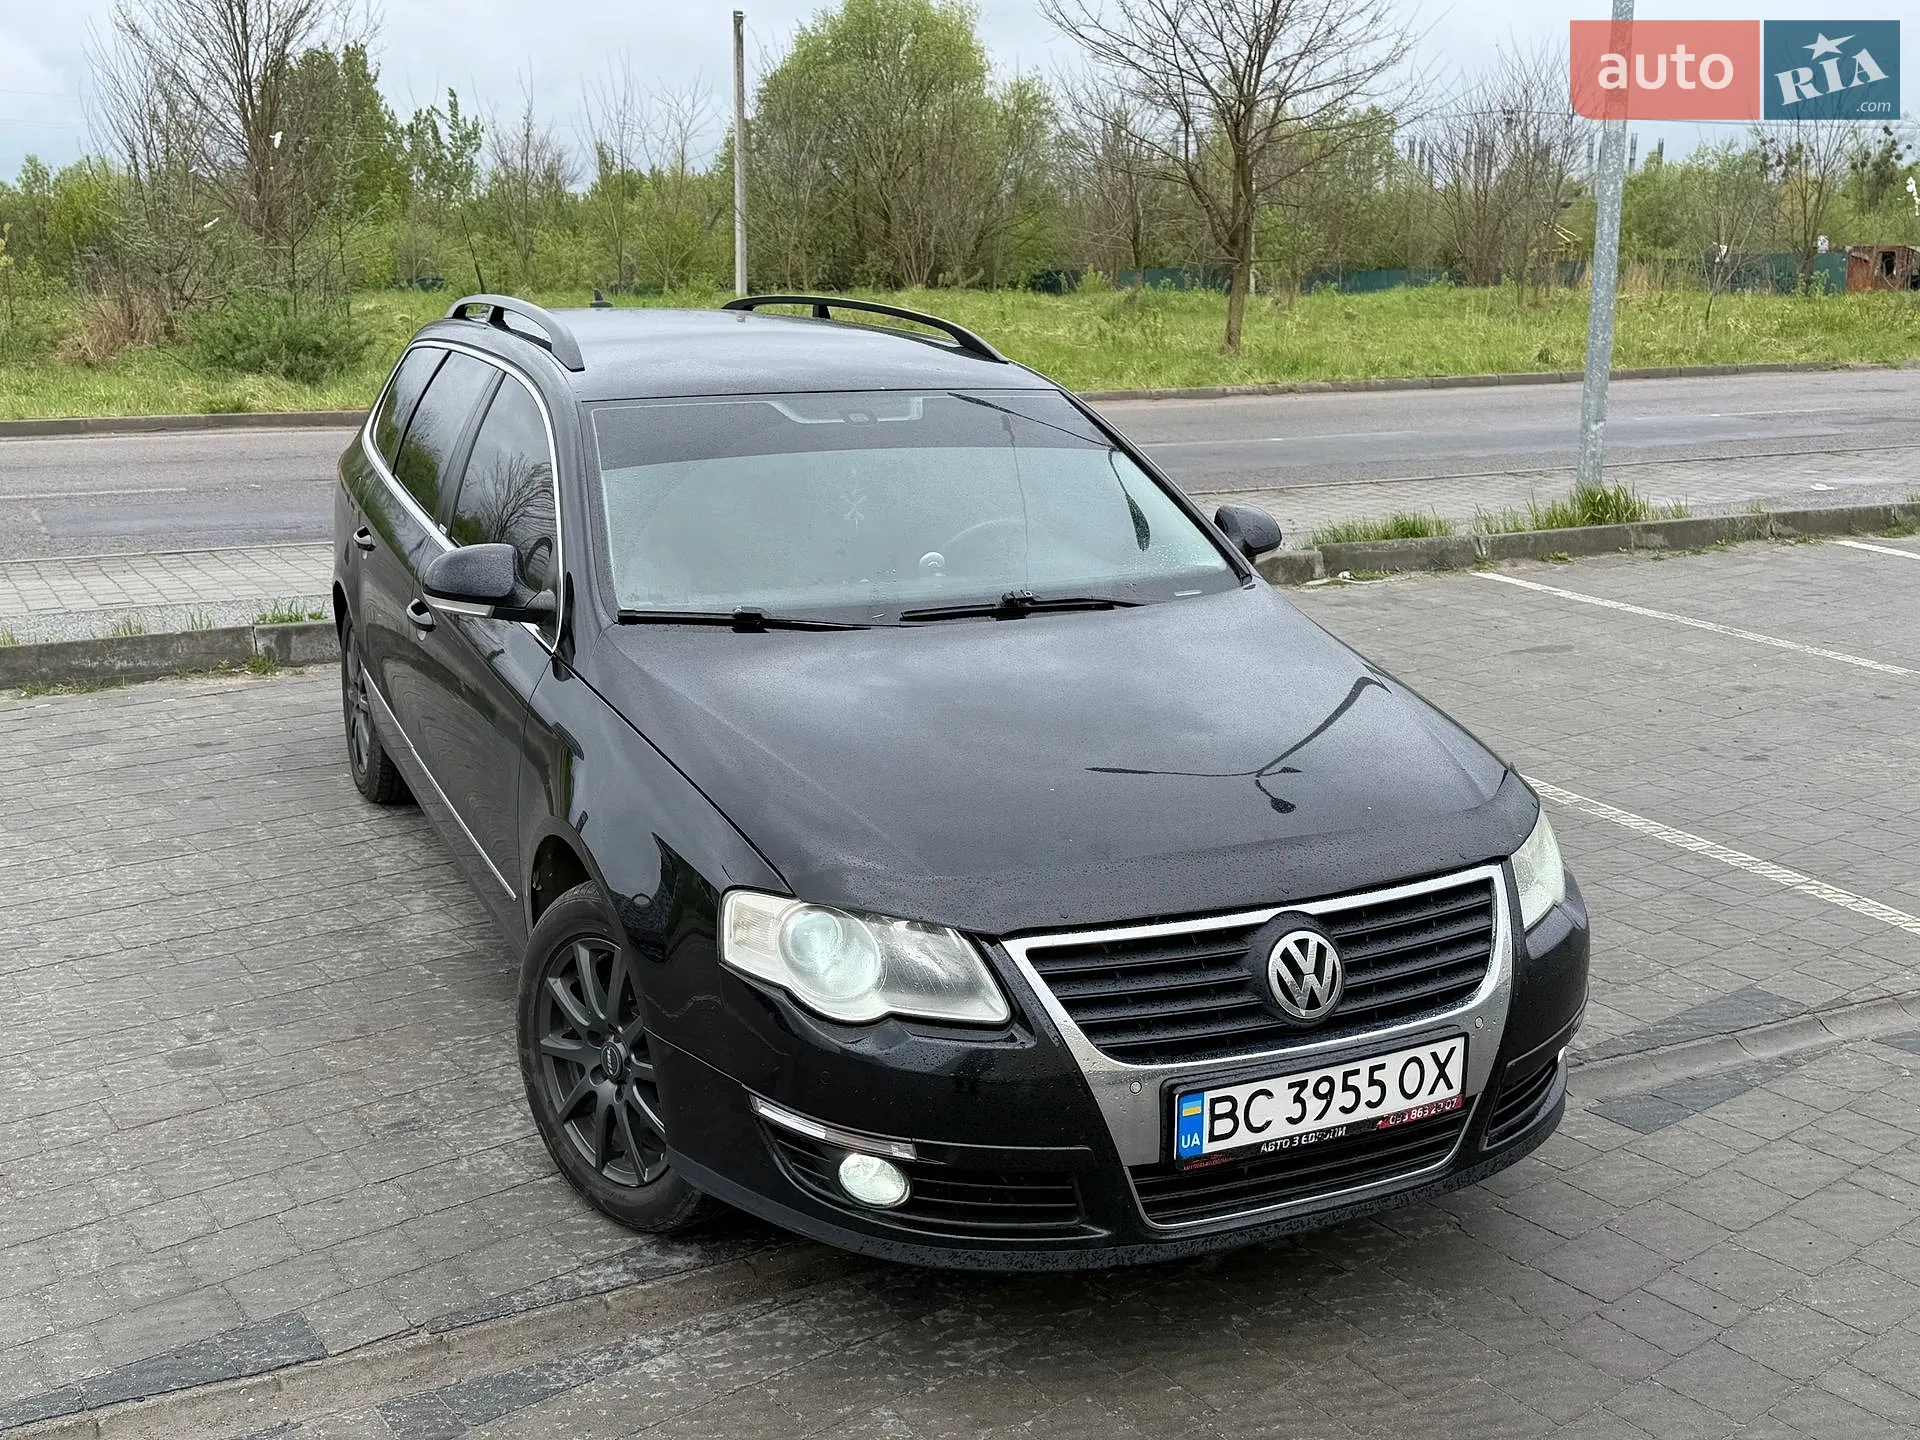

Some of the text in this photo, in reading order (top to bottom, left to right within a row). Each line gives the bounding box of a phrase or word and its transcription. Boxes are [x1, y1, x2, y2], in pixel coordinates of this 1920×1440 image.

[1207, 1046, 1457, 1144] BC 3955 OX
[1181, 1132, 1201, 1149] UA
